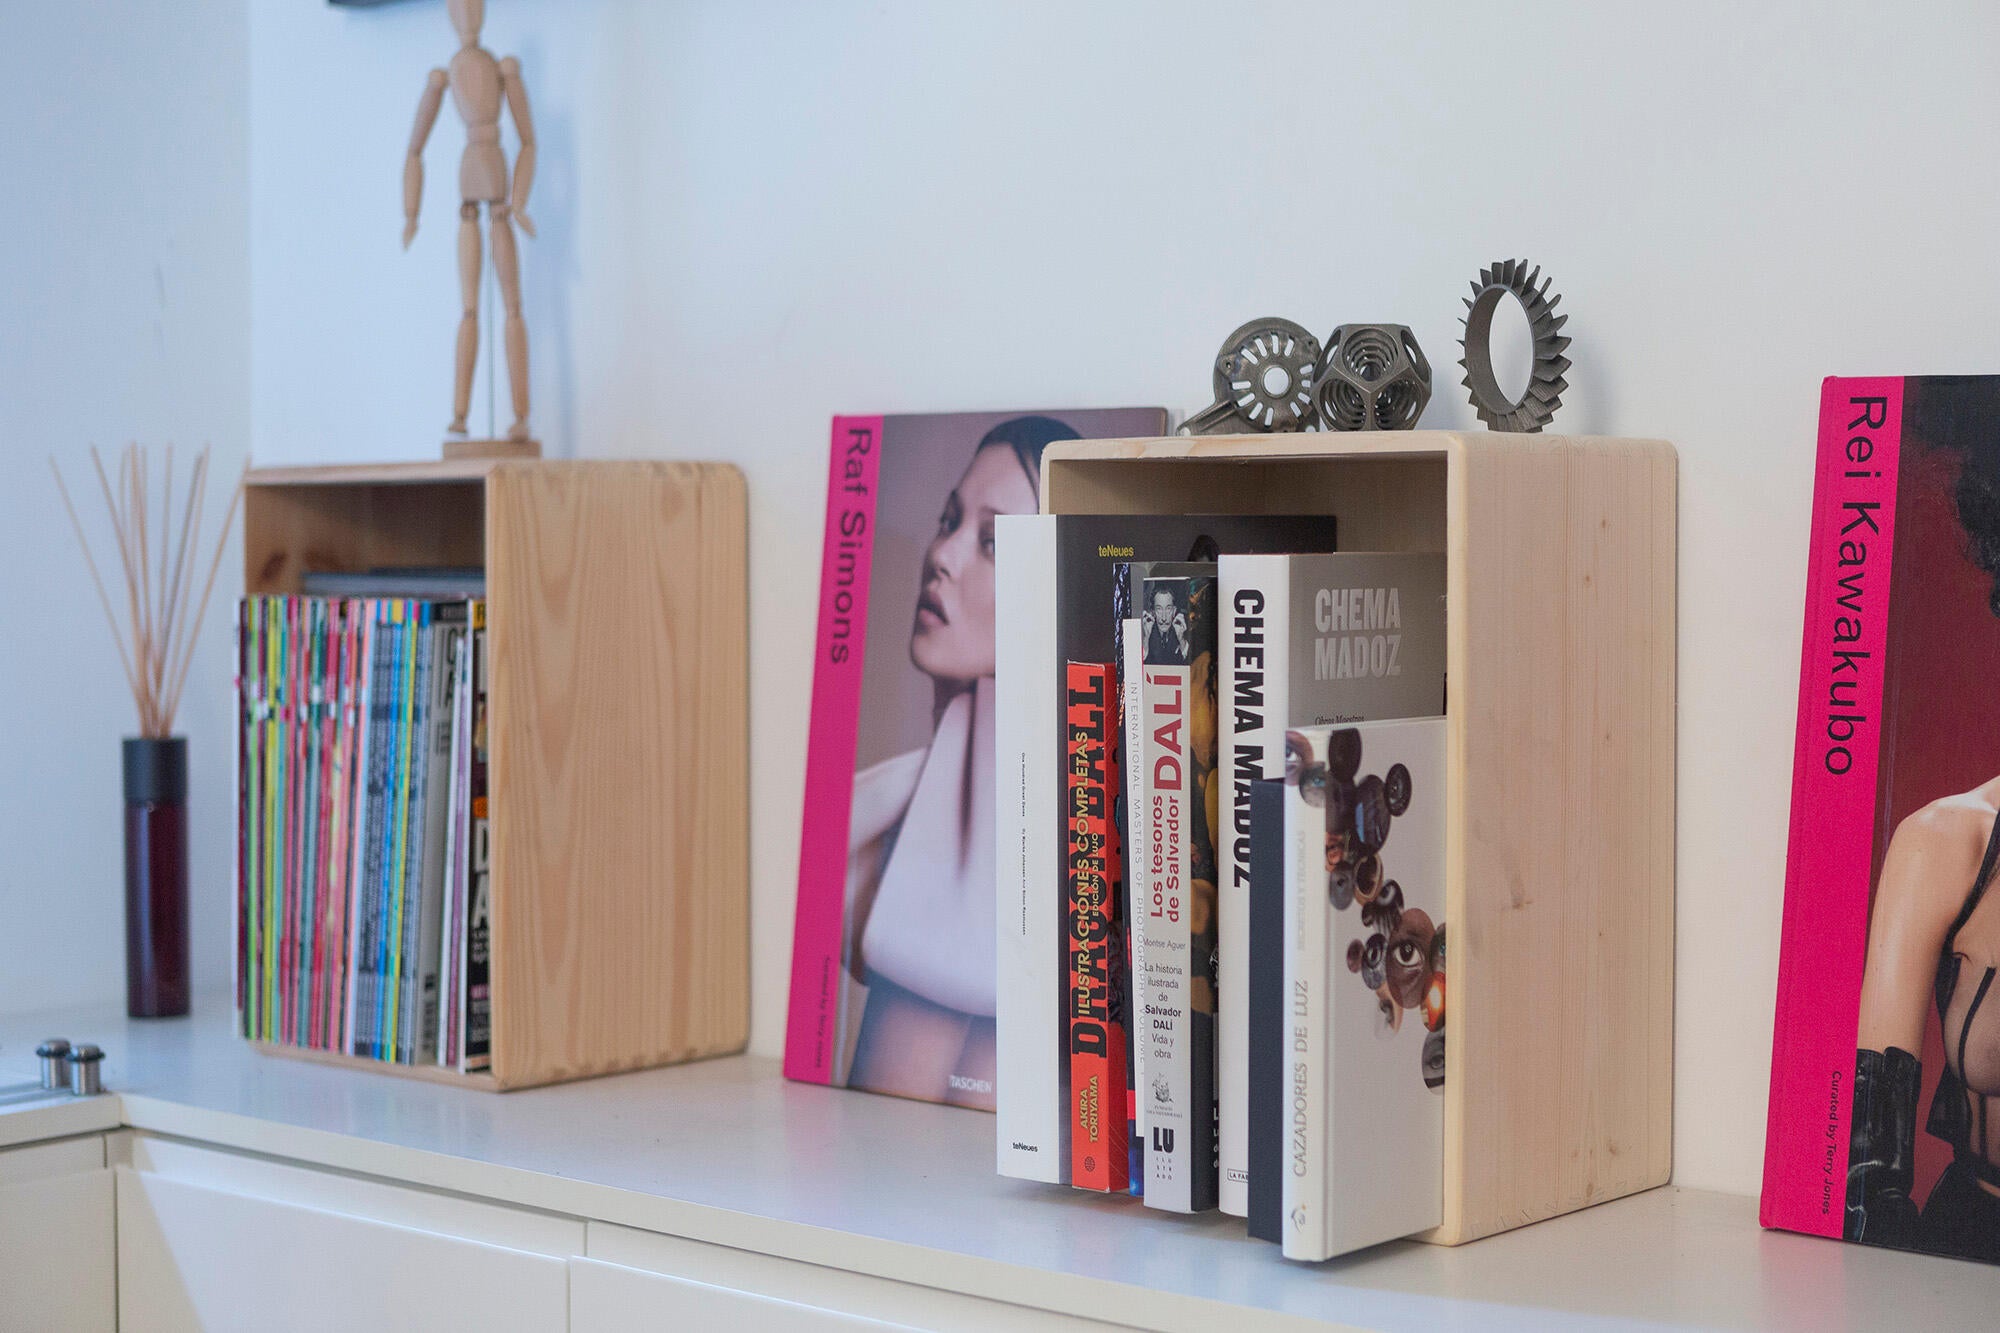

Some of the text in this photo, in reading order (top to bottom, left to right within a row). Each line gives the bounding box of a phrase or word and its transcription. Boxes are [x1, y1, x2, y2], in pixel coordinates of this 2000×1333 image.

[830, 428, 872, 664] Raf Simons
[1098, 544, 1135, 557] teNeues
[1824, 396, 1888, 776] Rei Kawakubo
[1315, 587, 1401, 633] CHEMA
[1233, 588, 1265, 734] CHEMA
[1314, 634, 1402, 681] MADOZ
[1130, 681, 1141, 791] INTERNATIONAL
[1146, 672, 1183, 791] DALÍ
[1133, 798, 1143, 865] MASTERS
[1069, 675, 1108, 1058] DRAGON BALL
[1075, 731, 1091, 1015] ILUSTRACIONES COMPLETAS
[1090, 832, 1100, 917] EDICIÓN DE LUJO
[1135, 871, 1144, 889] OF
[1150, 795, 1163, 918] Los tesoros
[1166, 795, 1179, 923] de Salvador
[1144, 962, 1183, 976] La historia
[1167, 940, 1186, 952] Aguer
[1147, 978, 1179, 990] ilustrada
[1157, 992, 1168, 1003] de
[1145, 1004, 1182, 1018] Salvador
[1153, 1018, 1173, 1031] DALÍ
[1151, 1033, 1175, 1048] Vida y
[1154, 1048, 1172, 1060] obra
[949, 1074, 993, 1093] TASCHEN
[1293, 979, 1309, 1178] CAZADORES DE LUZ
[1080, 1088, 1089, 1130] AKIRA
[1089, 1075, 1099, 1143] TORIYAMA
[1153, 1126, 1174, 1154] LU
[1821, 1070, 1842, 1215] Curated by Terry Jones
